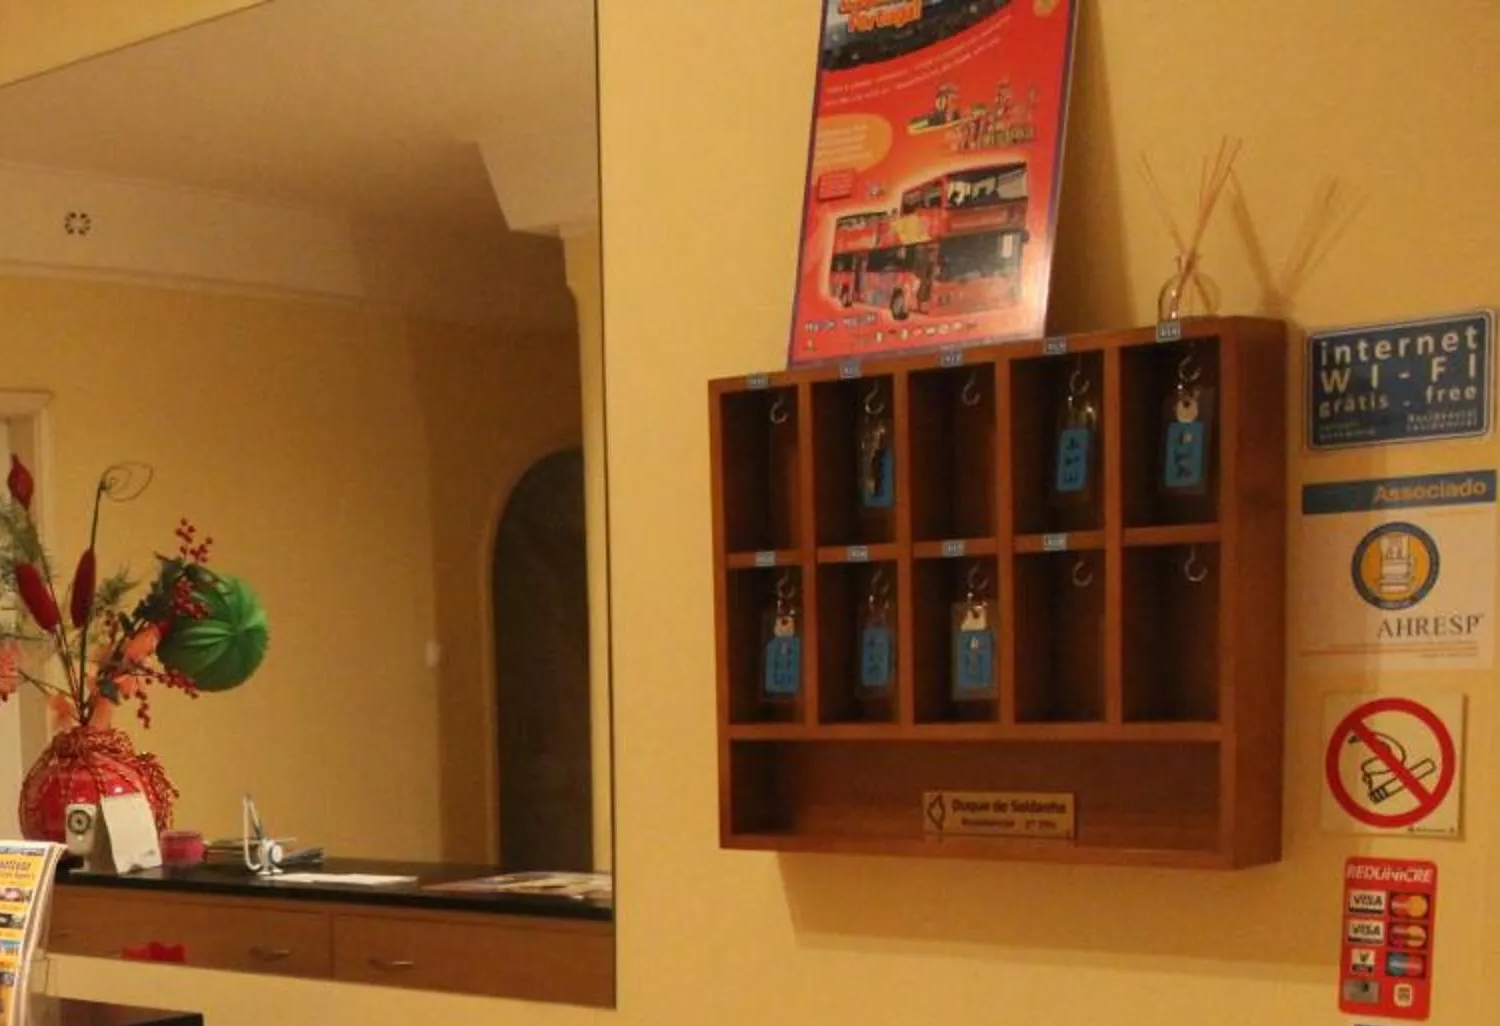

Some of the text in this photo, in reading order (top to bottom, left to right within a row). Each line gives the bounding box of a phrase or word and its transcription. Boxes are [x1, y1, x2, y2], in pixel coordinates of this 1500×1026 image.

[1320, 325, 1478, 366] internet
[1426, 385, 1478, 405] free
[1375, 477, 1487, 503] Associado
[1377, 613, 1480, 638] AHRESP
[1352, 923, 1381, 936] VISA
